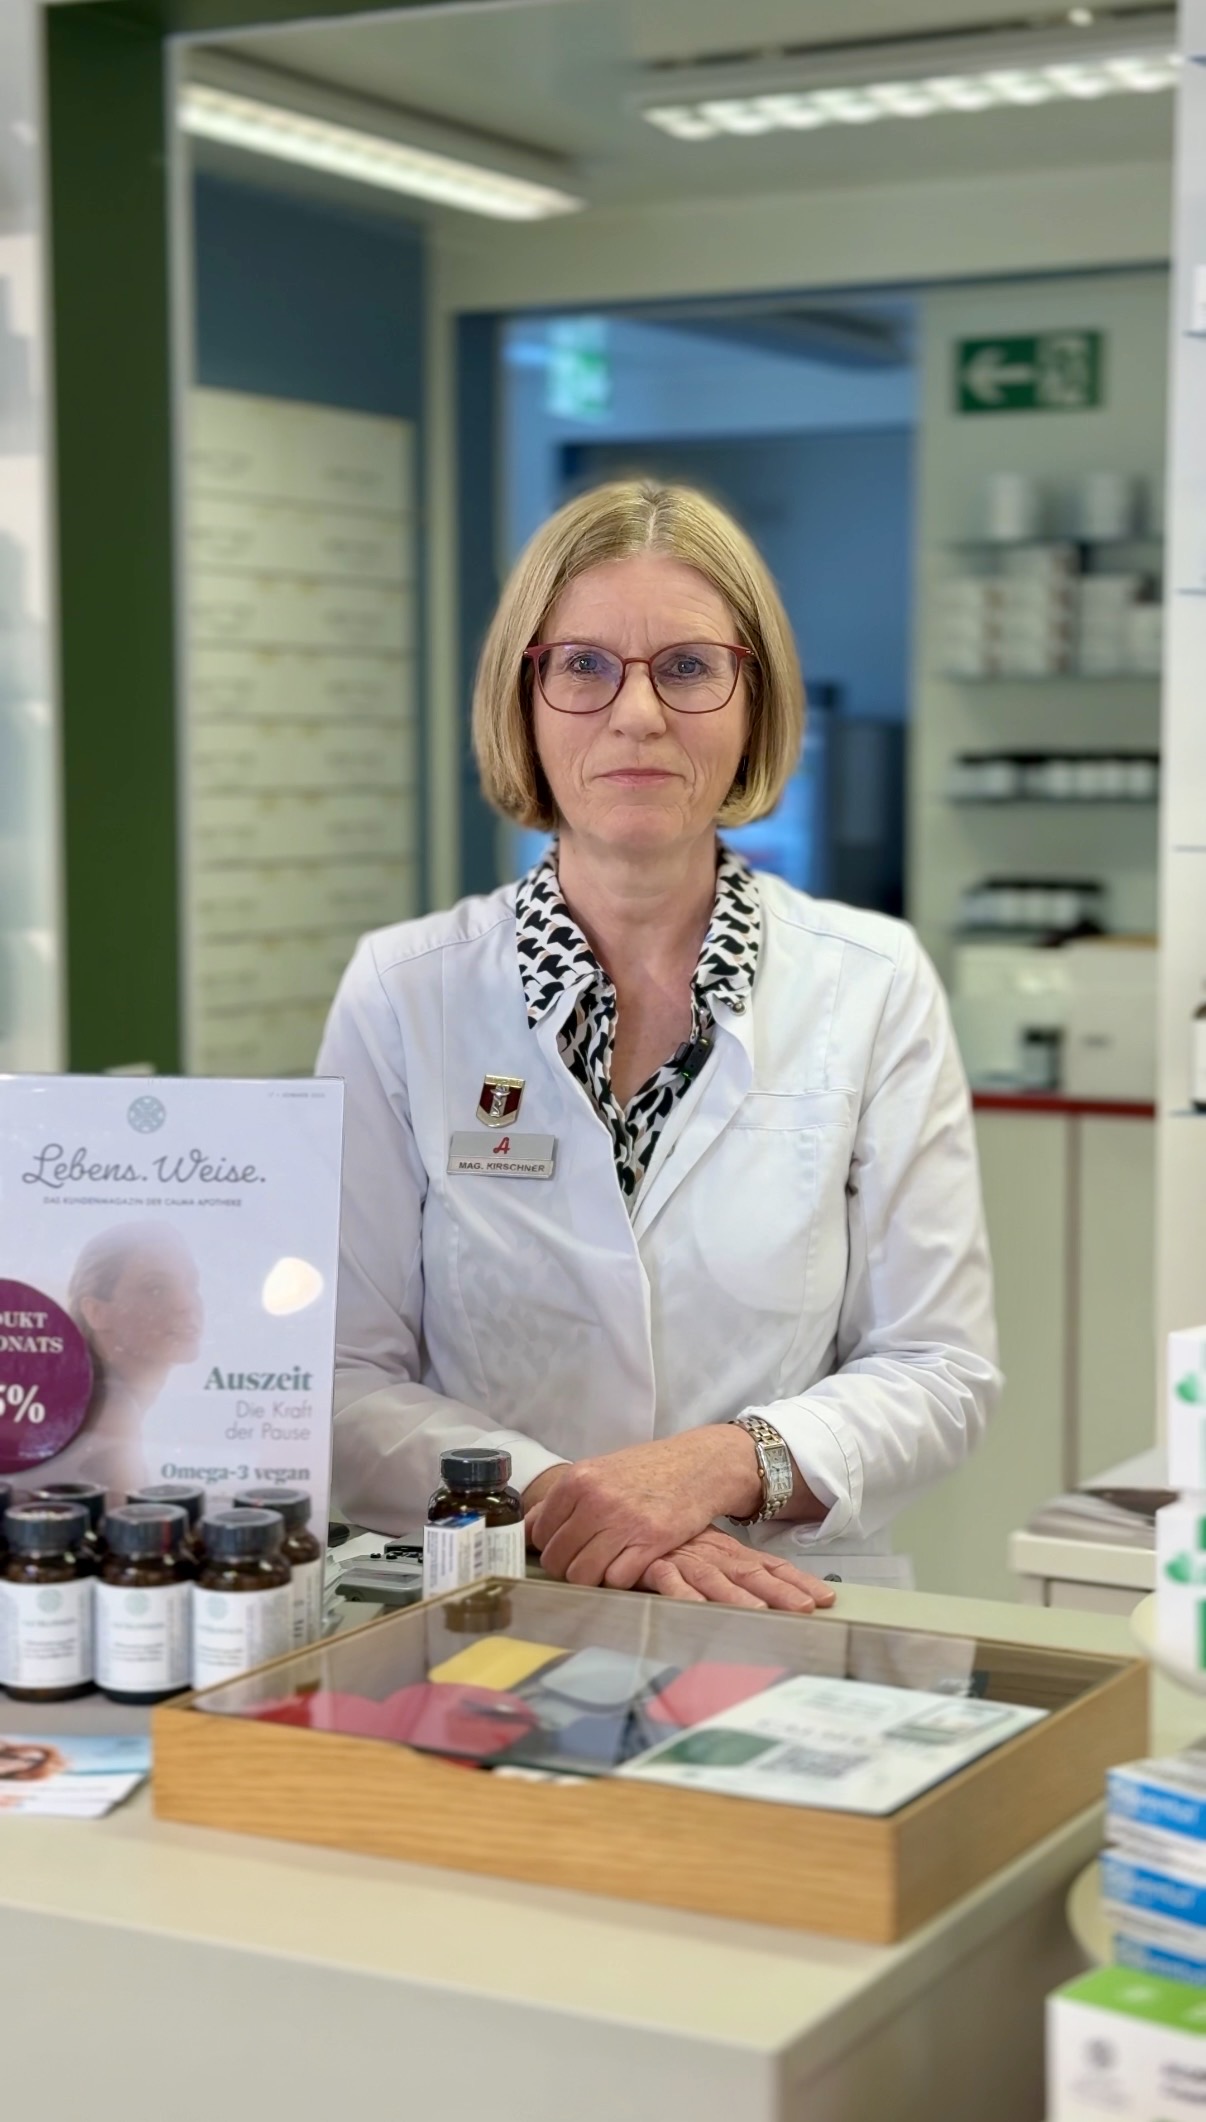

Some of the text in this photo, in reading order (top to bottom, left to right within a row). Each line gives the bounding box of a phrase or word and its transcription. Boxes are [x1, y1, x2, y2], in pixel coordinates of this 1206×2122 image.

[459, 1162, 545, 1172] MAG. KIRSCHNER
[63, 1196, 143, 1205] KUNDENMAGAZIN
[198, 1198, 242, 1208] APOTHEKE
[0, 1311, 48, 1328] UKT
[203, 1366, 313, 1391] Auszeit
[235, 1400, 312, 1419] Die Kraft
[225, 1421, 311, 1440] der Pause
[161, 1463, 311, 1484] Omega-3 vegan
